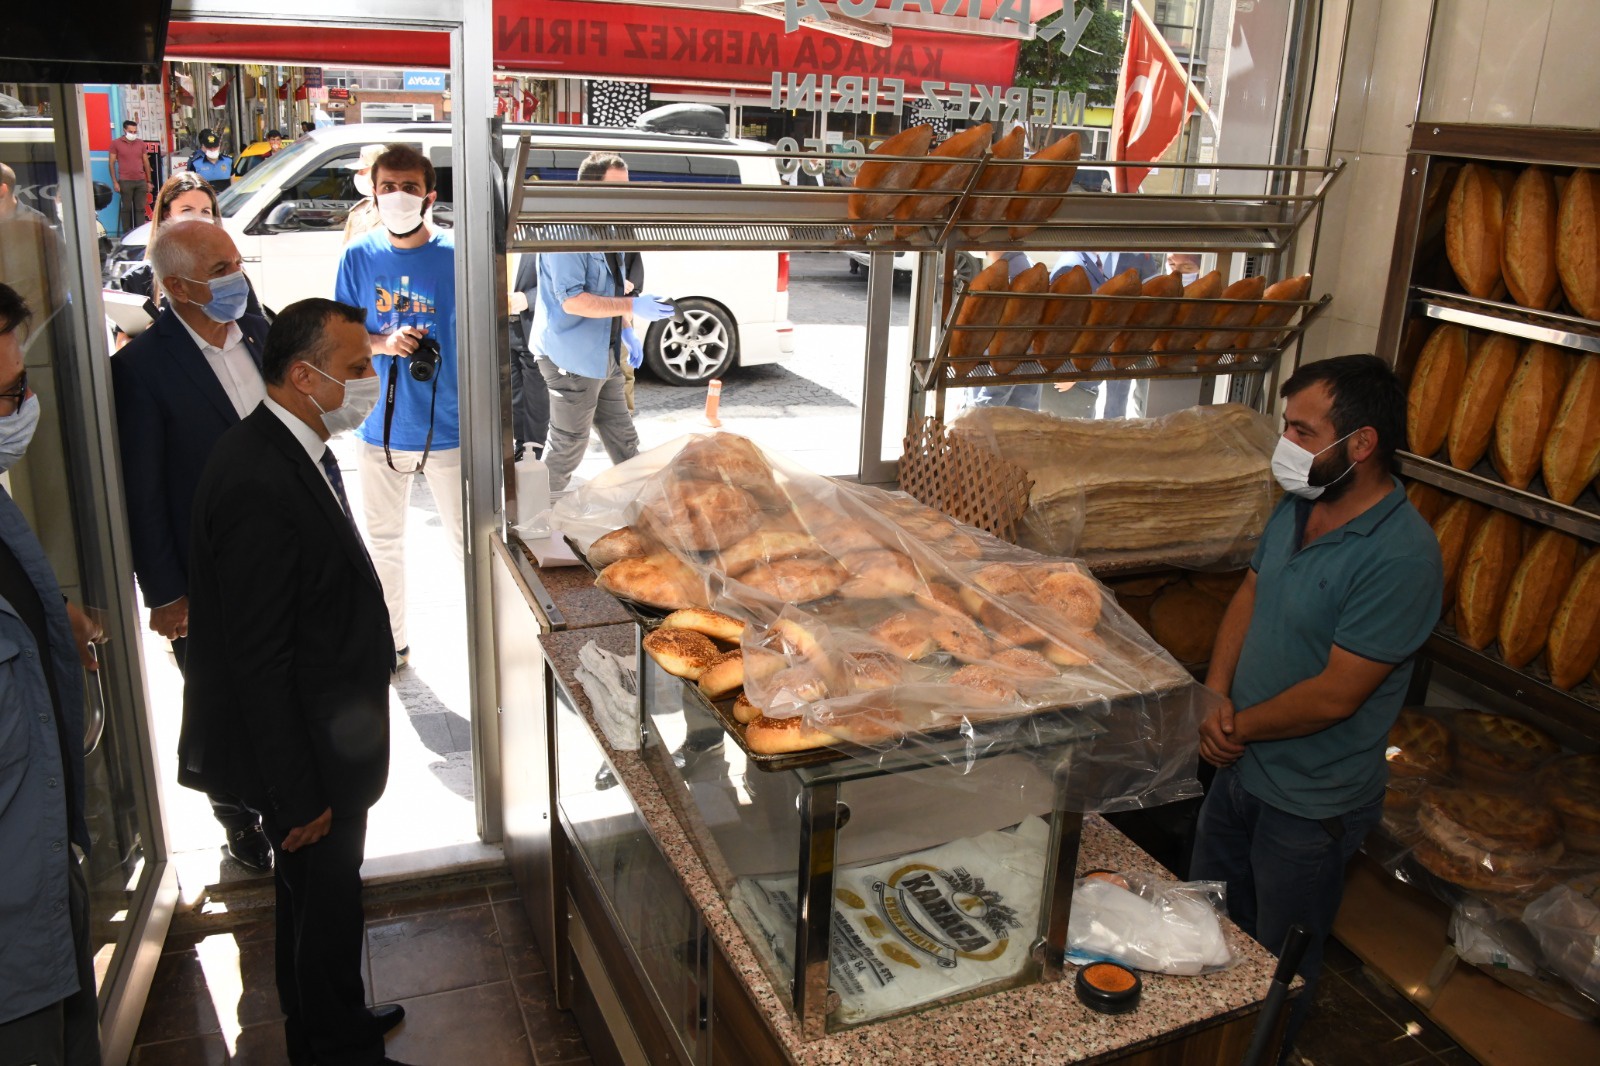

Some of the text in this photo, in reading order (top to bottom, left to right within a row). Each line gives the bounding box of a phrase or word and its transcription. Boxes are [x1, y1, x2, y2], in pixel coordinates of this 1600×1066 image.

[408, 77, 441, 86] AYGAZ
[901, 873, 991, 952] KARACA
[855, 960, 866, 972] 84
